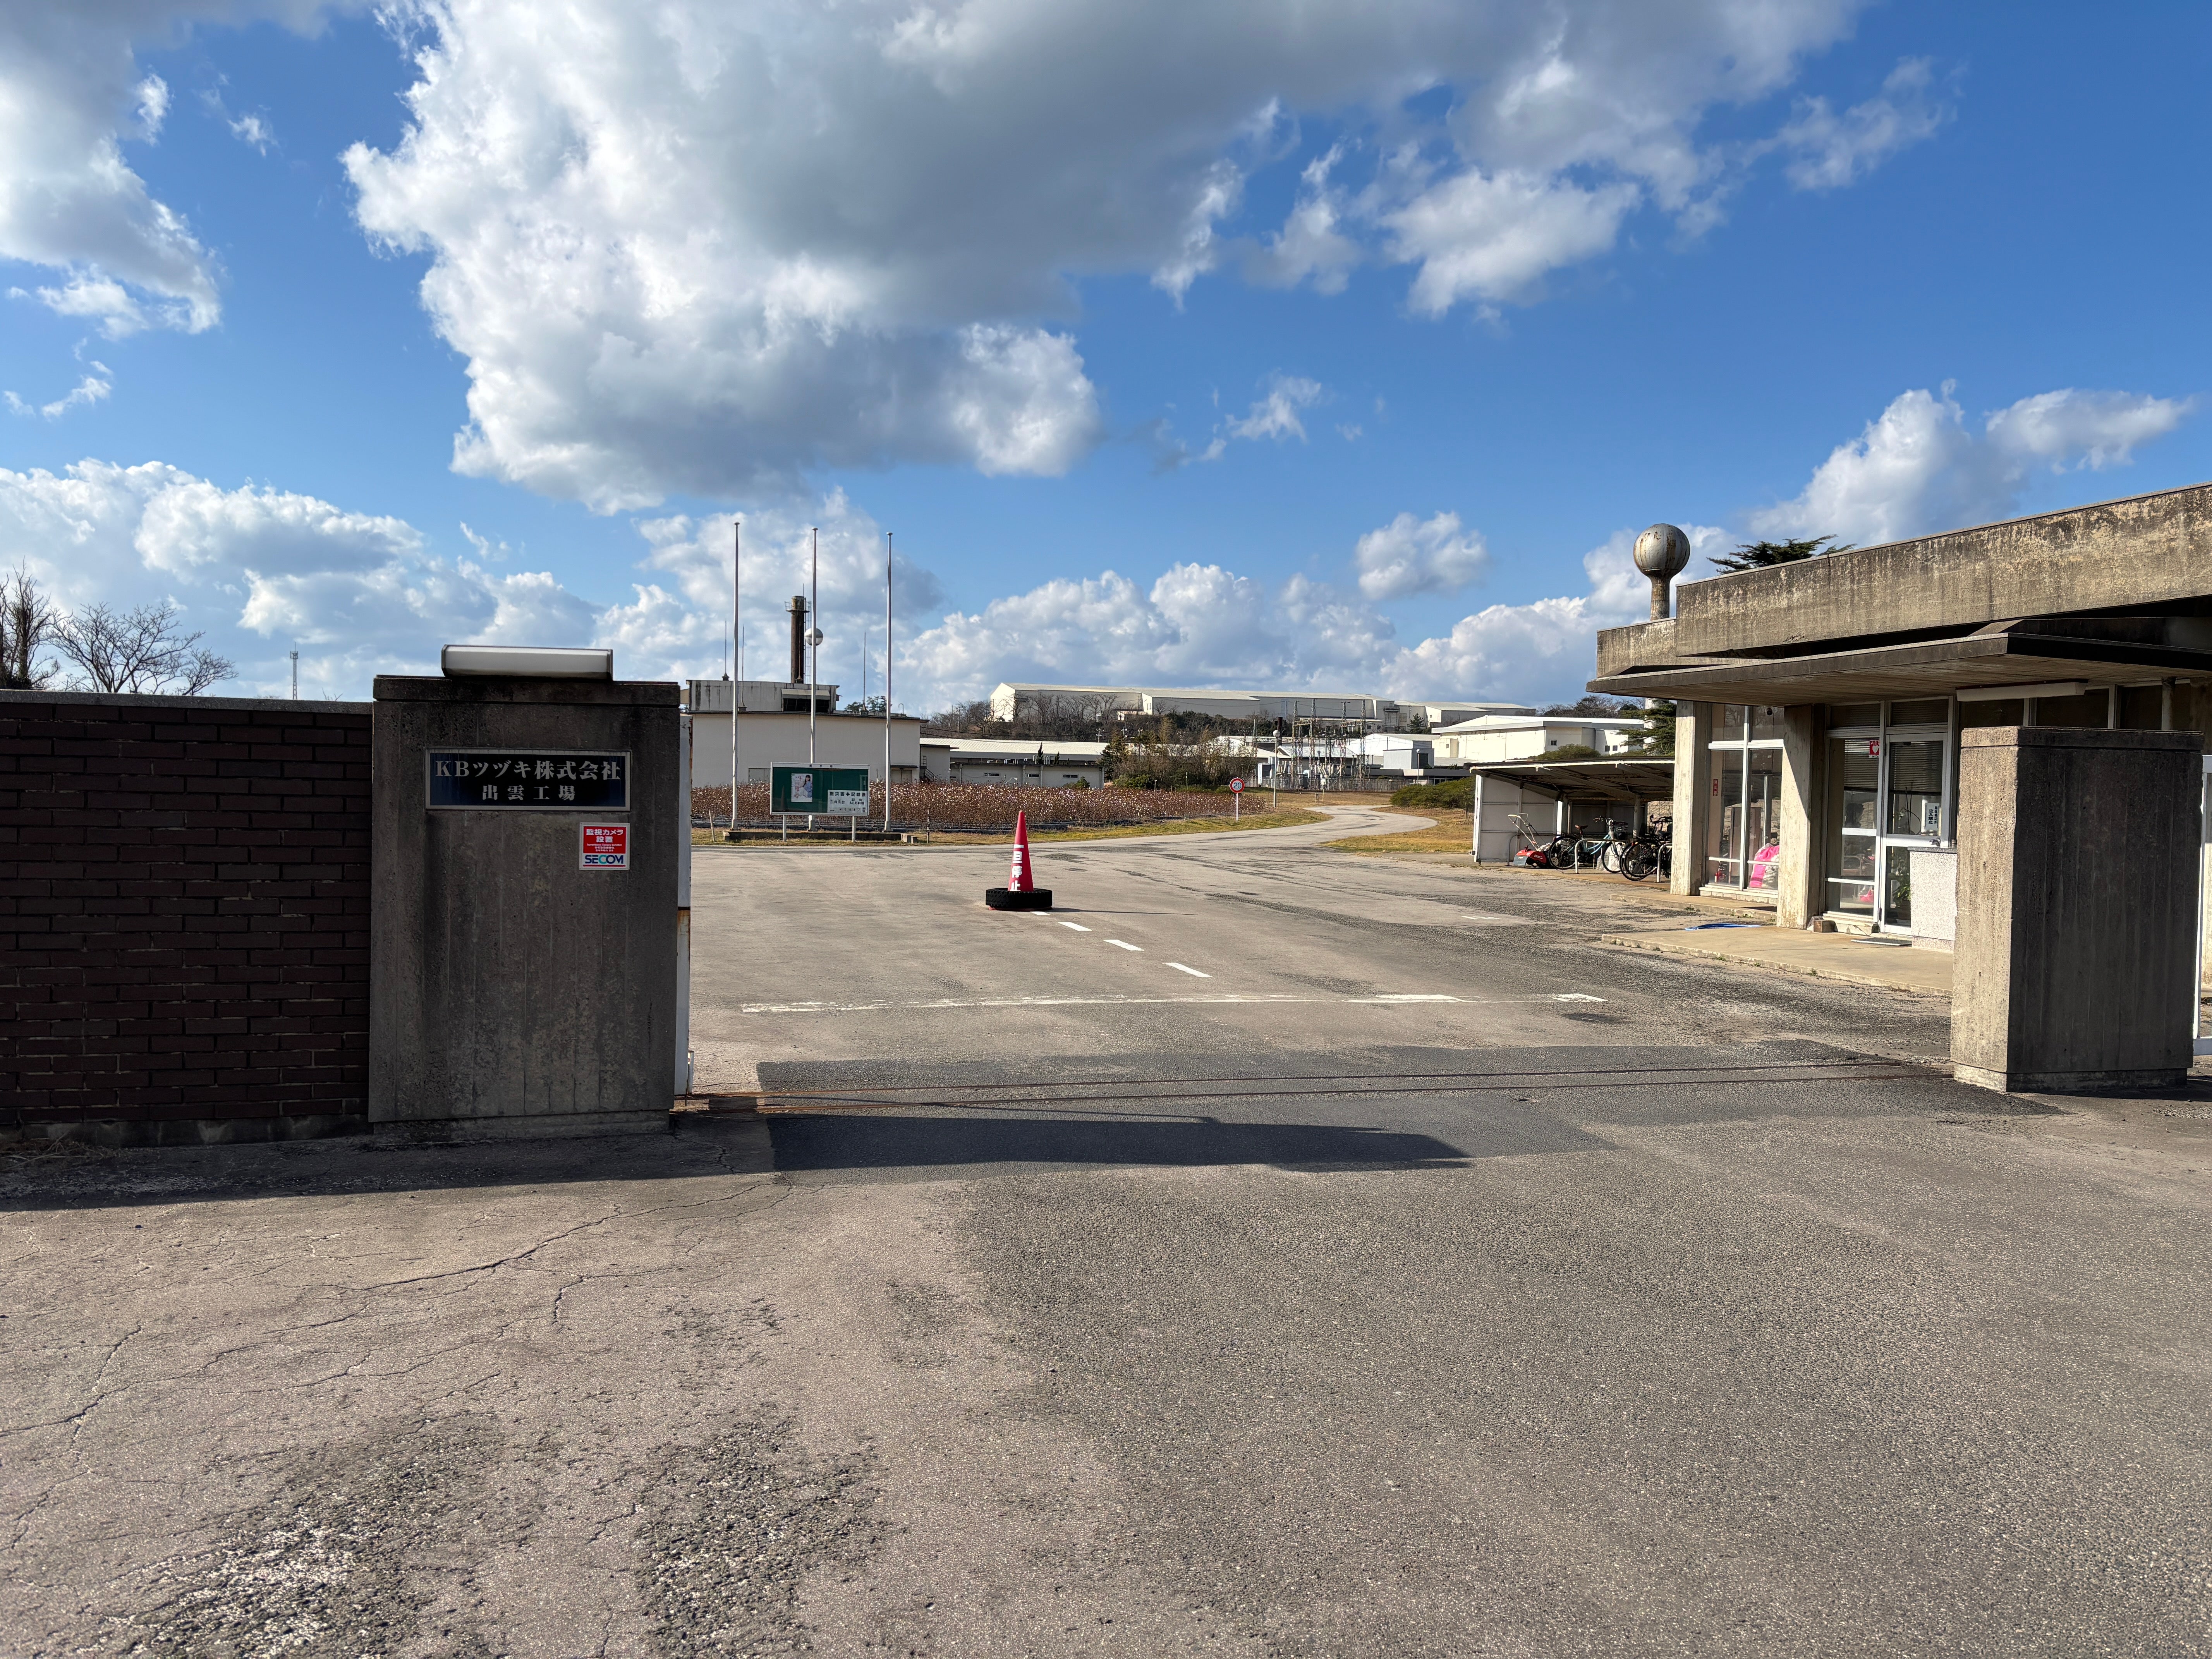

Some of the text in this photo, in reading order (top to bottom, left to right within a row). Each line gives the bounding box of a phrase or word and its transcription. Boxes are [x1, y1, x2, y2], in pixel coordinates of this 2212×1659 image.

[435, 760, 622, 780] KBツヅキ株式会社
[482, 784, 575, 801] 出雲工場
[585, 854, 624, 864] SECOM
[1010, 844, 1024, 891] 一旦停止
